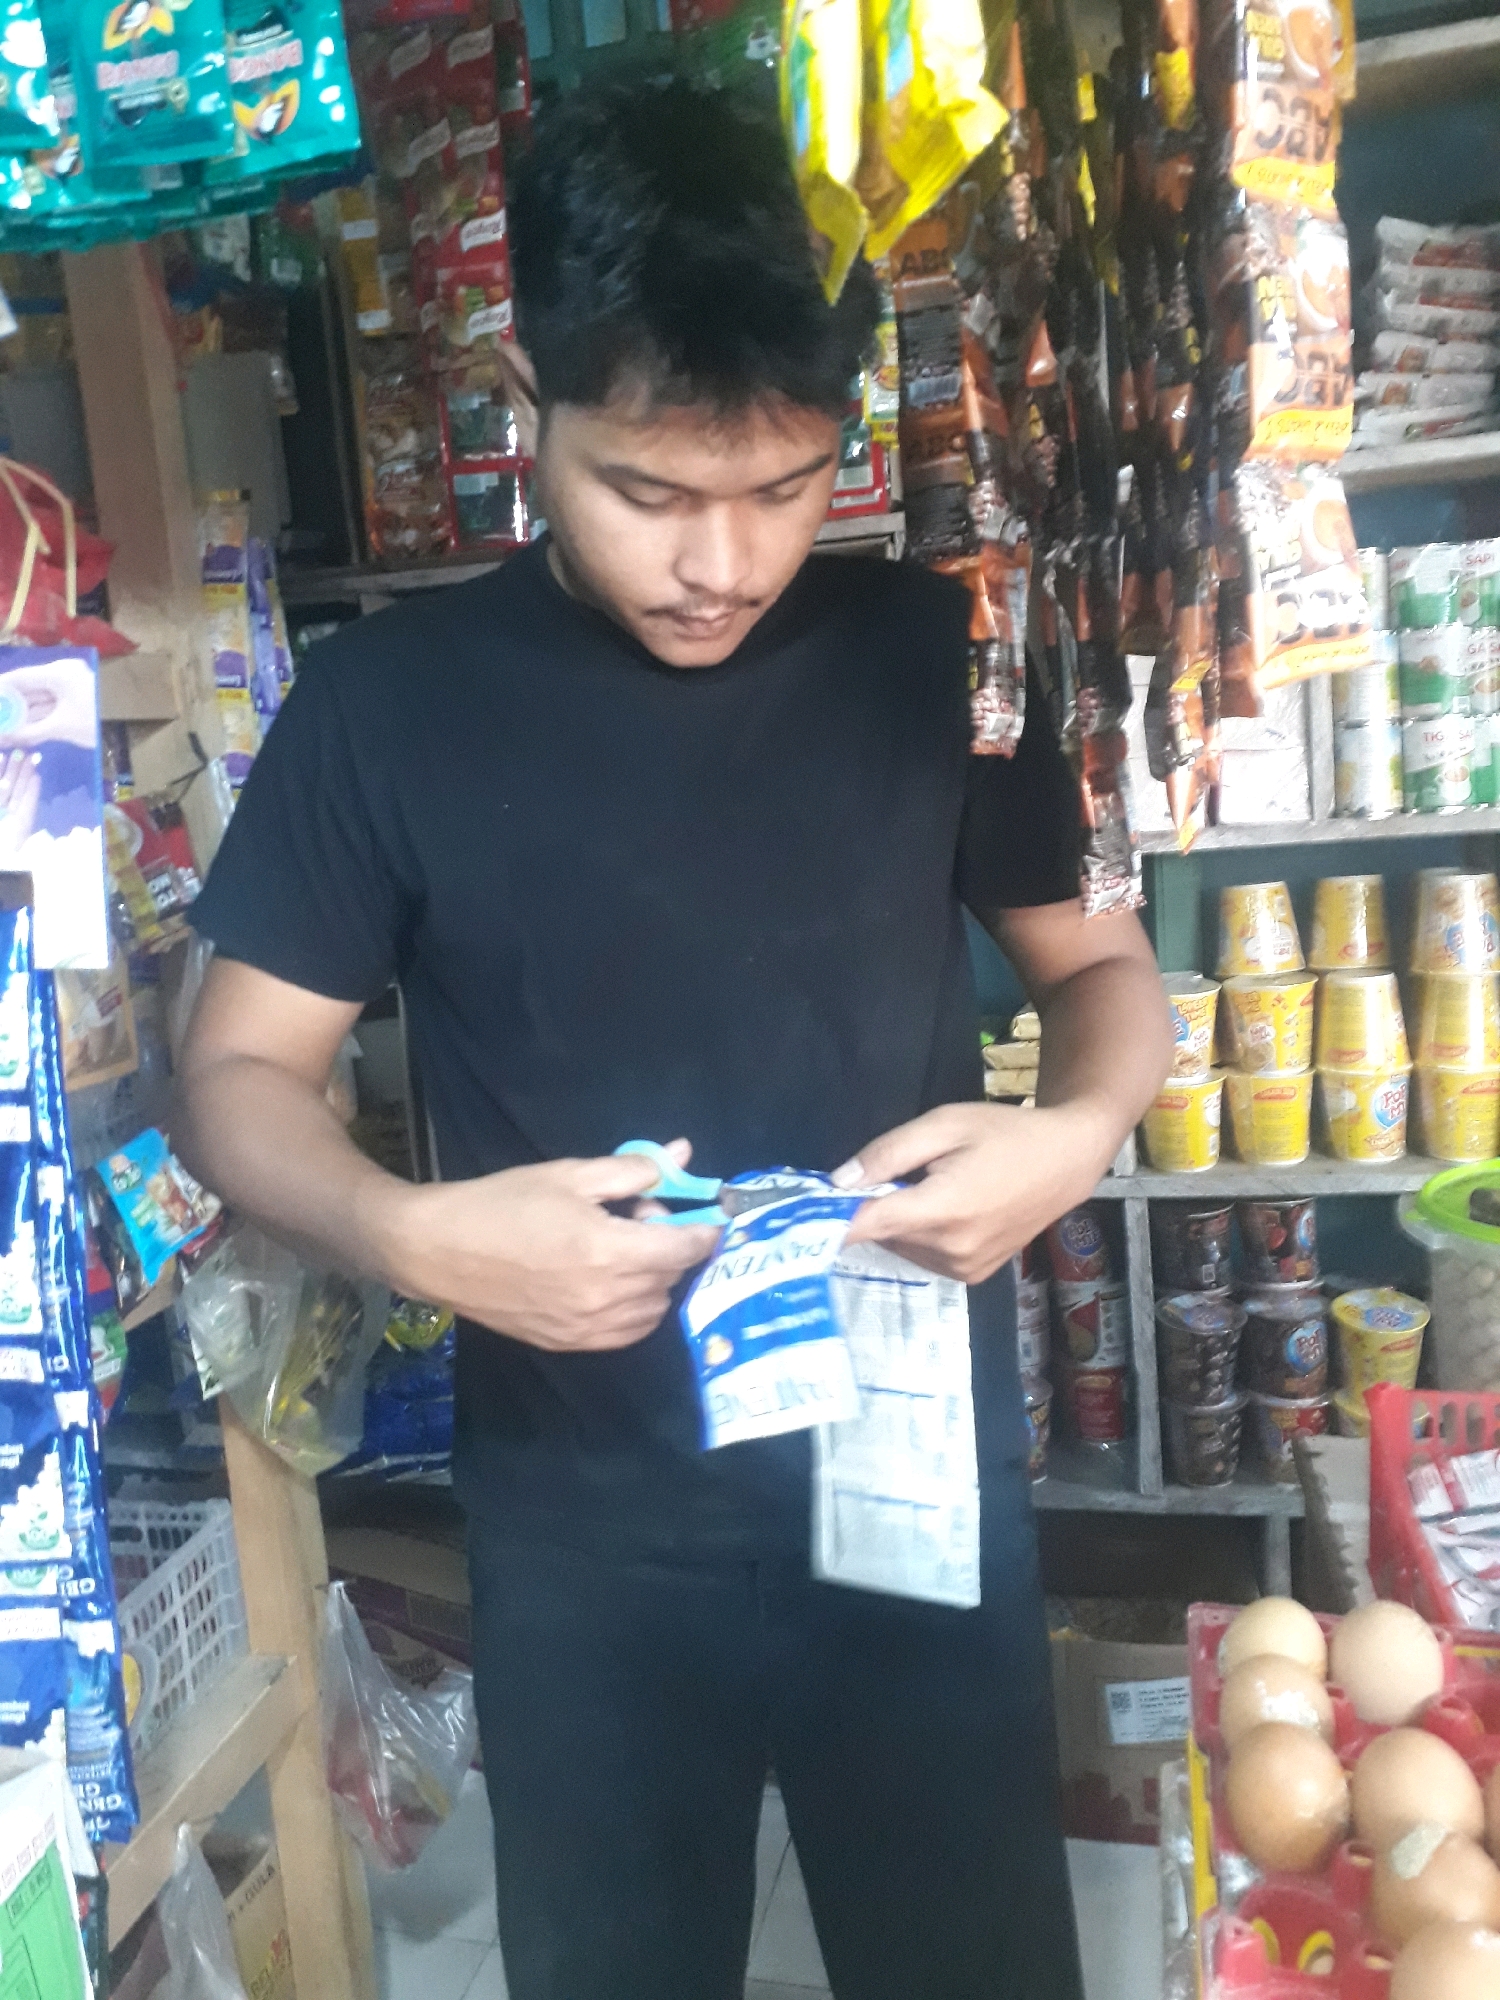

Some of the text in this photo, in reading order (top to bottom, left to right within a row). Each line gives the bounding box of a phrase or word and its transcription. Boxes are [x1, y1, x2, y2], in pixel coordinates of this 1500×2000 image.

[1465, 552, 1496, 566] SAPI
[1422, 731, 1451, 743] TIG
[701, 1236, 830, 1291] PANTENE
